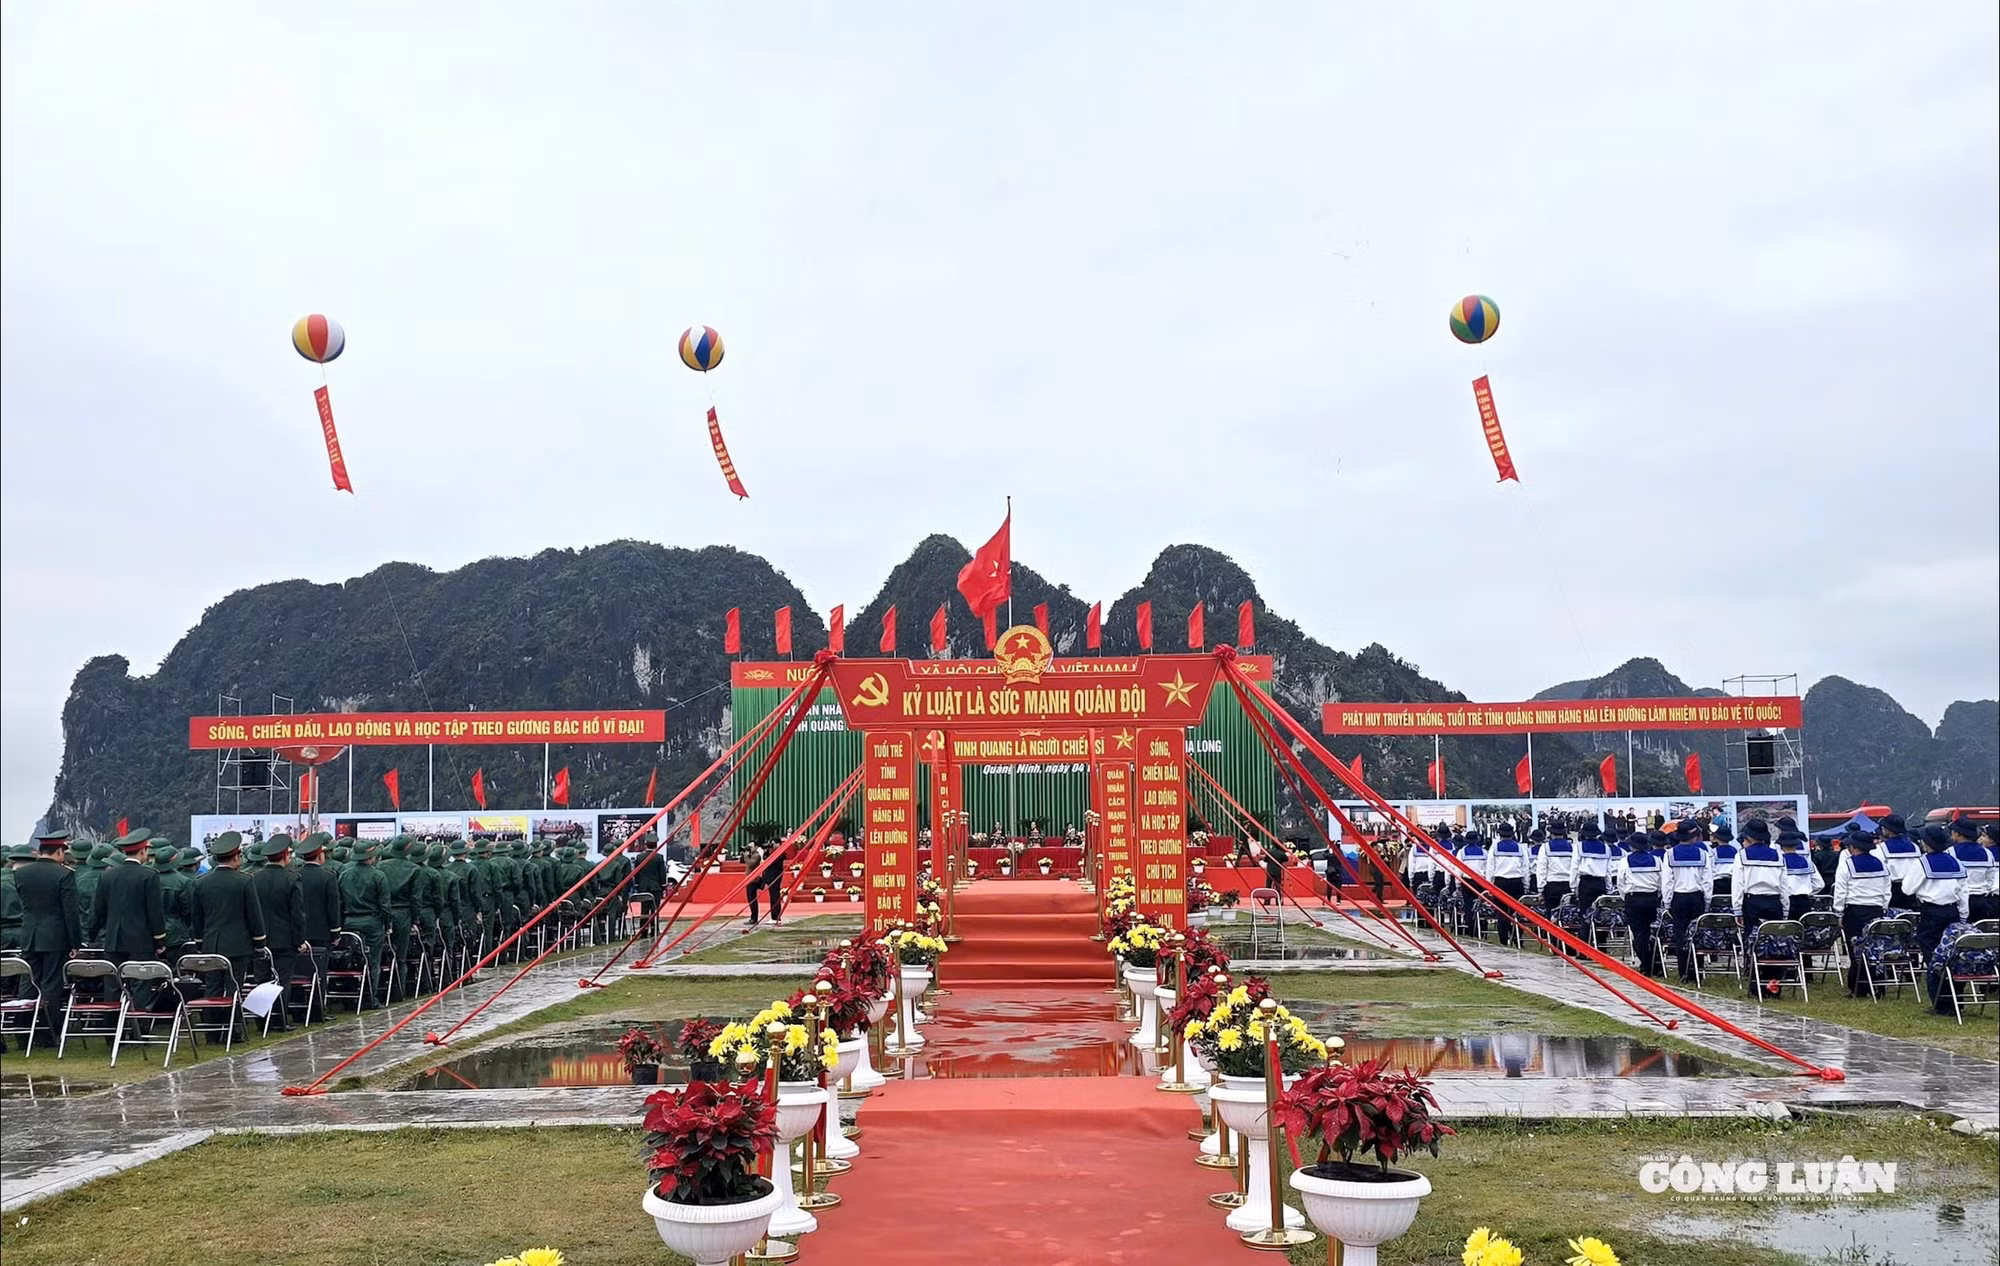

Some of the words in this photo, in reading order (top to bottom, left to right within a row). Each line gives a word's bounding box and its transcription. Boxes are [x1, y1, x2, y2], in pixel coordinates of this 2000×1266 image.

[903, 684, 922, 716] KỶ
[927, 686, 962, 721] LUẬT
[967, 686, 985, 715] LÀ
[990, 685, 1020, 715] SỨC
[1025, 688, 1069, 720] MẠNH
[1074, 684, 1116, 716] QUÂN
[1120, 683, 1146, 718] ĐỘI
[1342, 709, 1363, 726] PHÁT
[1365, 711, 1381, 726] HUY
[1416, 707, 1445, 727] THỐNG,
[1447, 706, 1465, 726] TUỔI
[1467, 707, 1482, 725] TRẺ
[1485, 707, 1503, 725] TỈNH
[1506, 707, 1533, 726] QUẢNG
[1536, 710, 1556, 724] NINH
[1558, 706, 1581, 724] HĂNG
[1584, 706, 1598, 723] HÁI
[1600, 706, 1616, 723] LÊN
[1618, 705, 1646, 723] ĐƯỜNG
[1648, 704, 1667, 722] LÀM
[1669, 705, 1696, 725] NHIỆM
[1699, 707, 1710, 724] VỤ
[1712, 702, 1729, 721] BẢO
[1731, 703, 1742, 724] VỆ
[1743, 700, 1754, 720] TỔ
[1756, 700, 1781, 721] QUỐC!
[209, 720, 248, 741] SỐNG,
[252, 719, 291, 739] CHIẾN
[294, 718, 325, 738] ĐẤU,
[328, 722, 352, 737] LAO
[355, 719, 391, 739] ĐỘNG
[395, 719, 411, 736] VÀ
[415, 721, 440, 739] HỌC
[444, 718, 468, 739] TẬP
[472, 720, 503, 735] THEO
[507, 719, 550, 735] GƯƠNG
[554, 717, 579, 735] BÁC
[583, 715, 600, 734] HỒ
[604, 717, 616, 734] VĨ
[619, 719, 644, 737] ĐẠI!
[874, 739, 889, 758] TUỔI
[890, 740, 903, 758] TRẺ
[954, 740, 977, 756] VINH
[980, 740, 1012, 757] QUANG
[1015, 737, 1027, 756] LÀ
[1030, 736, 1060, 756] NGƯỜI
[1095, 736, 1104, 755] SĨ
[1150, 736, 1171, 758] SỐNG,
[1197, 740, 1222, 752] LONG
[880, 762, 897, 779] TỈNH
[1072, 764, 1085, 774] 04
[1142, 761, 1163, 781] CHIẾN
[1164, 760, 1180, 782] ĐẤU,
[867, 783, 891, 803] QUẢNG
[892, 787, 910, 801] NINH
[1108, 796, 1125, 807] CÁCH
[1144, 789, 1157, 805] LAO
[1158, 787, 1177, 809] ĐỘNG
[872, 807, 892, 823] HĂNG
[893, 806, 905, 823] HÁI
[1141, 811, 1151, 830] VÀ
[1151, 814, 1166, 833] HỌC
[1167, 811, 1180, 834] TẬP
[870, 828, 883, 844] LÊN
[1108, 851, 1128, 861] TRUNG
[1140, 839, 1157, 855] THEO
[1158, 838, 1182, 855] GƯƠNG
[881, 850, 897, 866] LÀM
[872, 871, 895, 891] NHIỆM
[896, 874, 906, 890] VỤ
[1146, 859, 1160, 879] CHỦ
[1160, 863, 1177, 883] TỊCH
[877, 892, 891, 909] BẢO
[893, 893, 902, 912] VỆ
[1140, 883, 1150, 904] HỒ
[1151, 885, 1163, 904] CHÍ
[1164, 888, 1183, 904] MINH
[873, 913, 883, 931] TỔ
